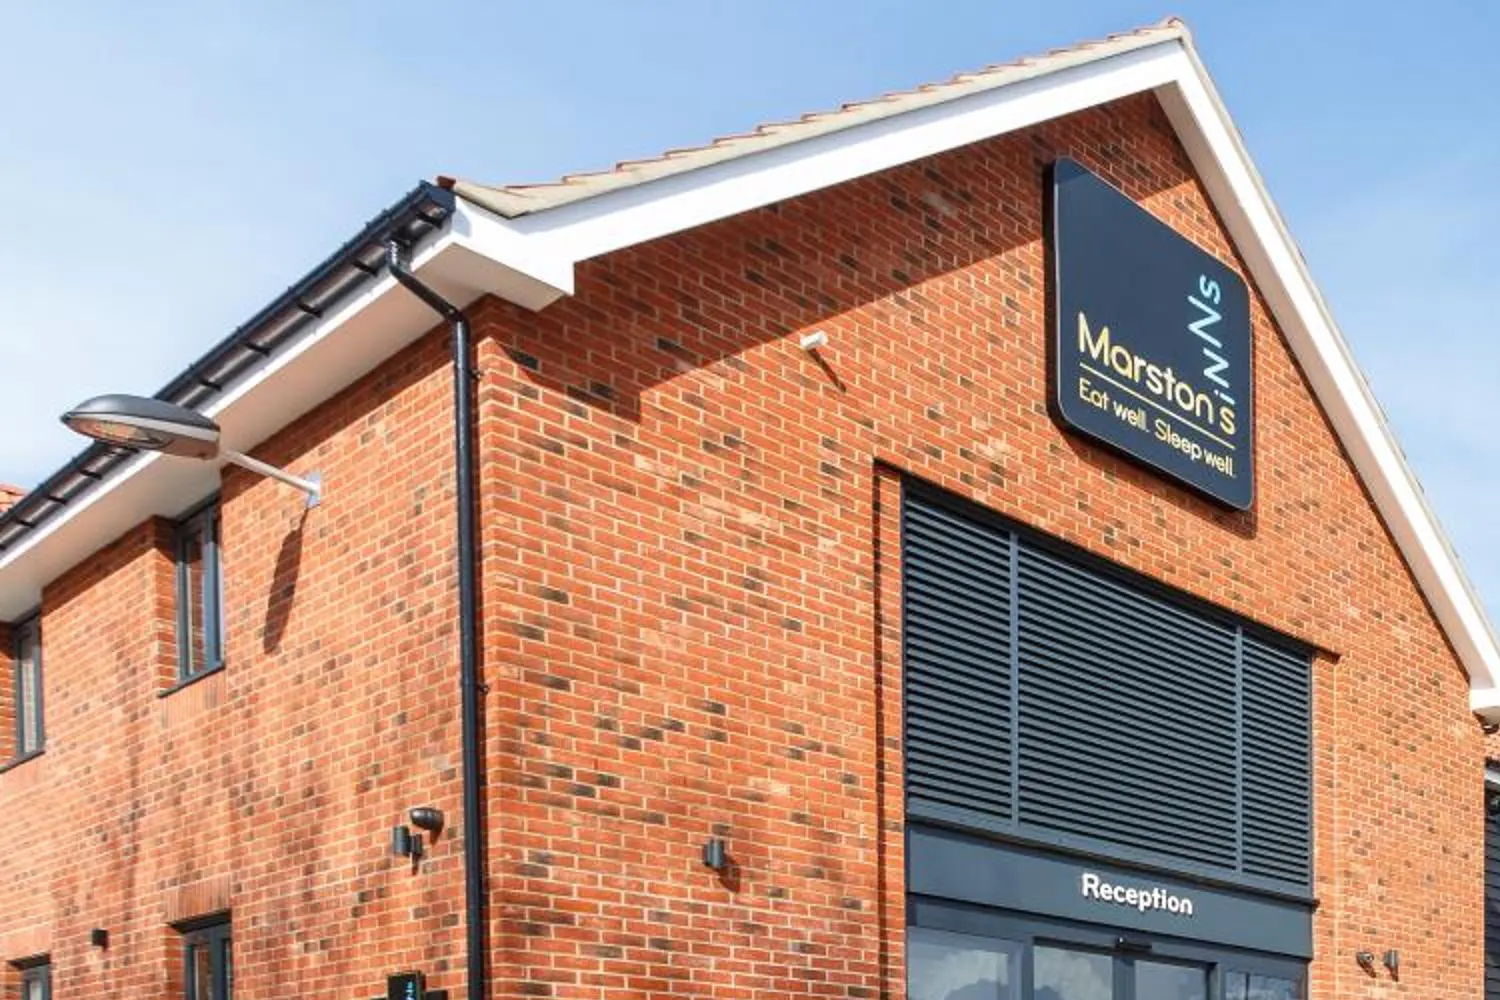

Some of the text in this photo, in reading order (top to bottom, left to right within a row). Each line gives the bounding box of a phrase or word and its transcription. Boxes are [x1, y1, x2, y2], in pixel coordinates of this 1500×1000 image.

[1078, 376, 1111, 412] Eat
[1154, 418, 1203, 463] Sleep
[1082, 872, 1193, 916] Reception
